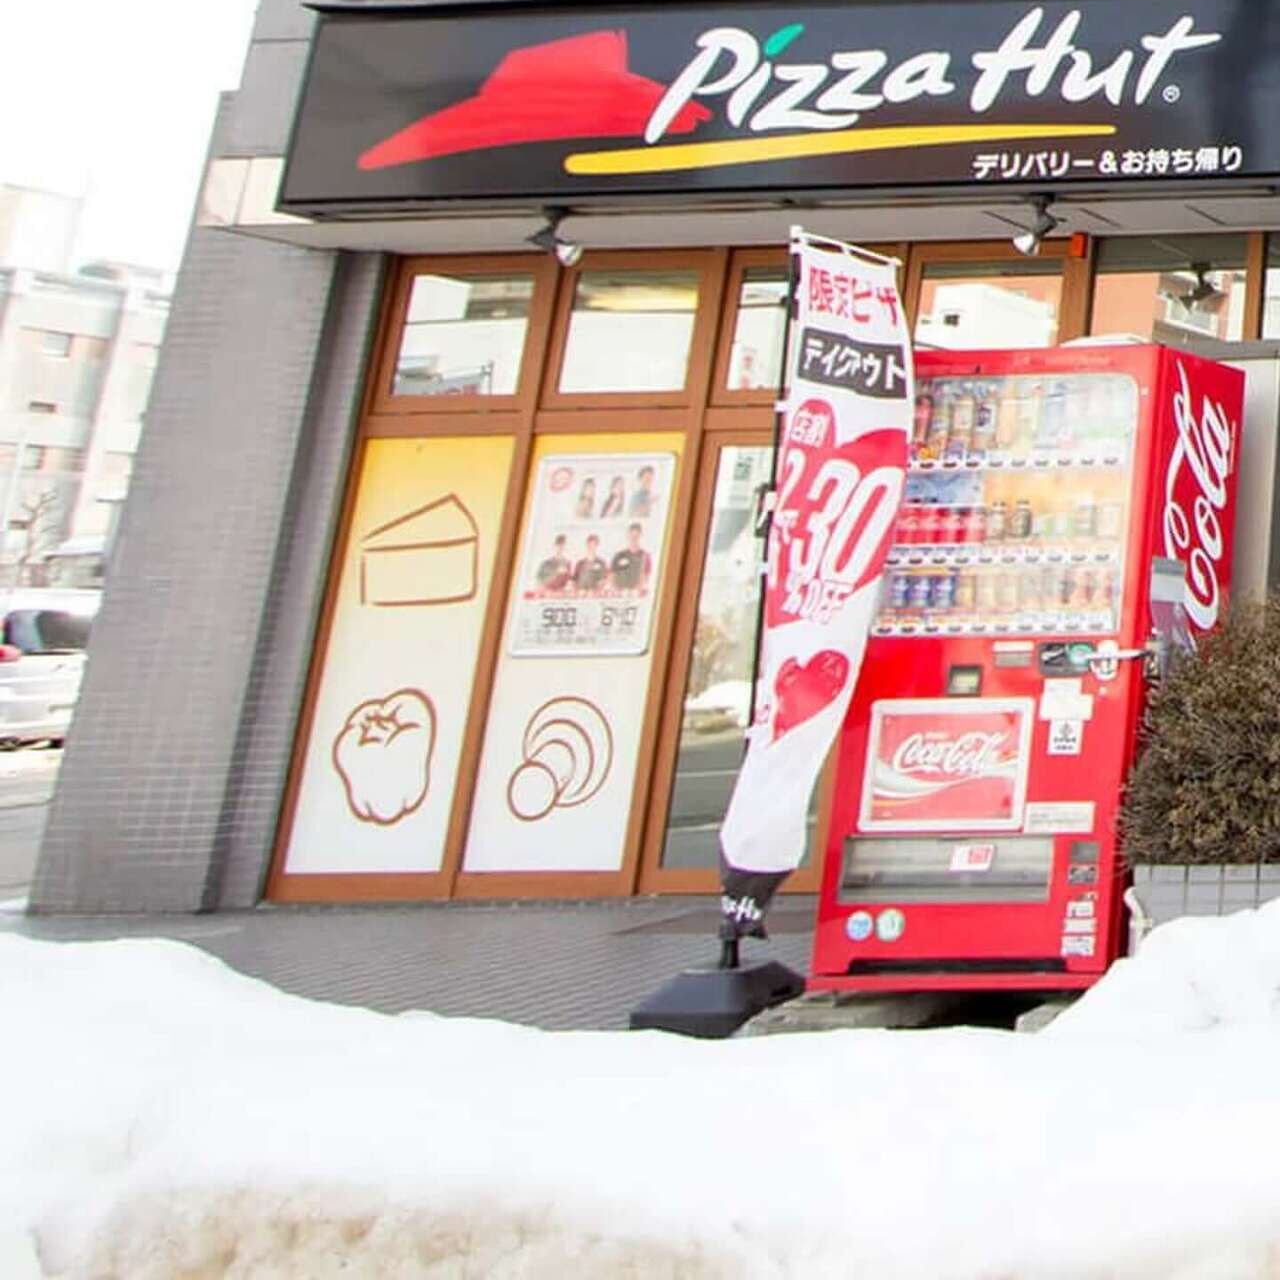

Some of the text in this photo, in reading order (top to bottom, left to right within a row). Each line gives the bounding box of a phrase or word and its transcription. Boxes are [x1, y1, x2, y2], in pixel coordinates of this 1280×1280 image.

[644, 6, 1222, 144] Pizza Hut
[972, 146, 1243, 180] デリバリー&お持ち帰り
[786, 460, 905, 593] 30
